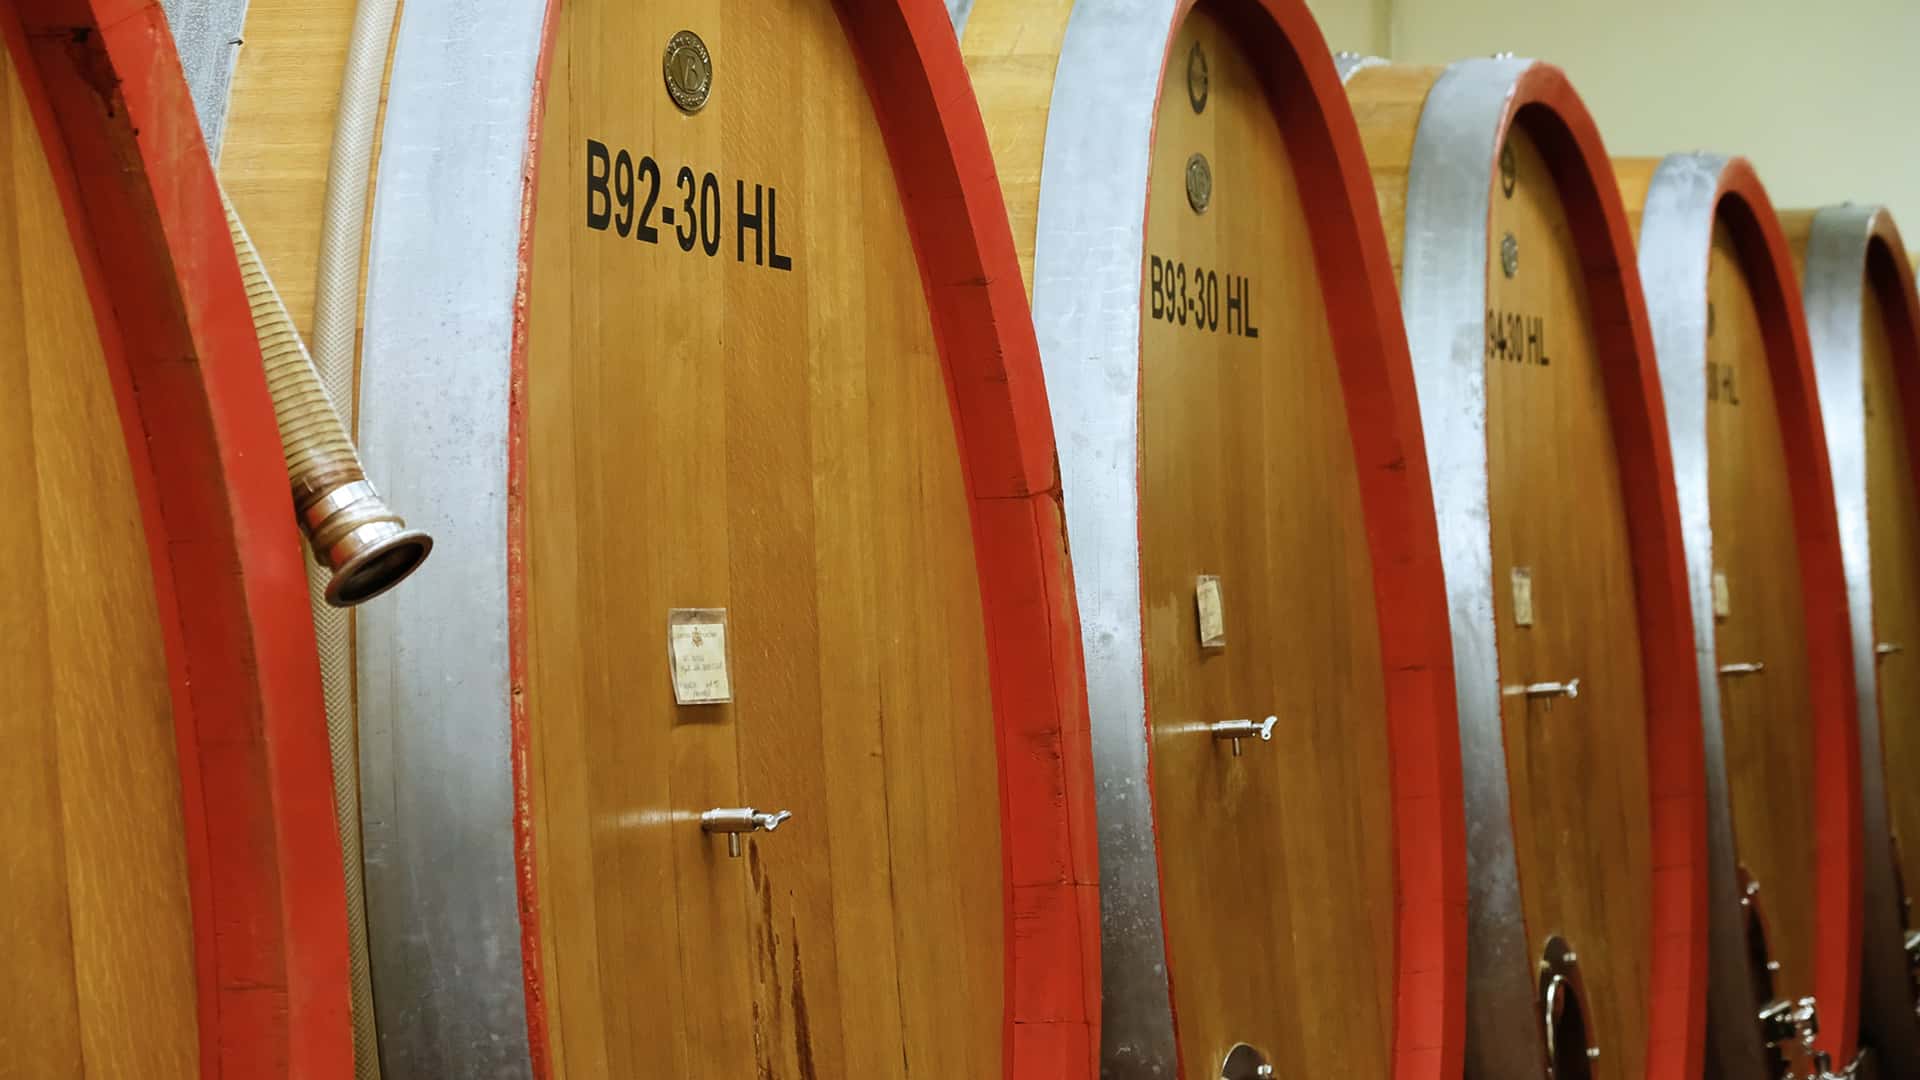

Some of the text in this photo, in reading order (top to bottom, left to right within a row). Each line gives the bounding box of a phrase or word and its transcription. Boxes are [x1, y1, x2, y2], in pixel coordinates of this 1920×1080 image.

[587, 138, 792, 271] B92-30 HL
[1151, 255, 1258, 338] B93-30 HL
[1526, 315, 1550, 366] HL
